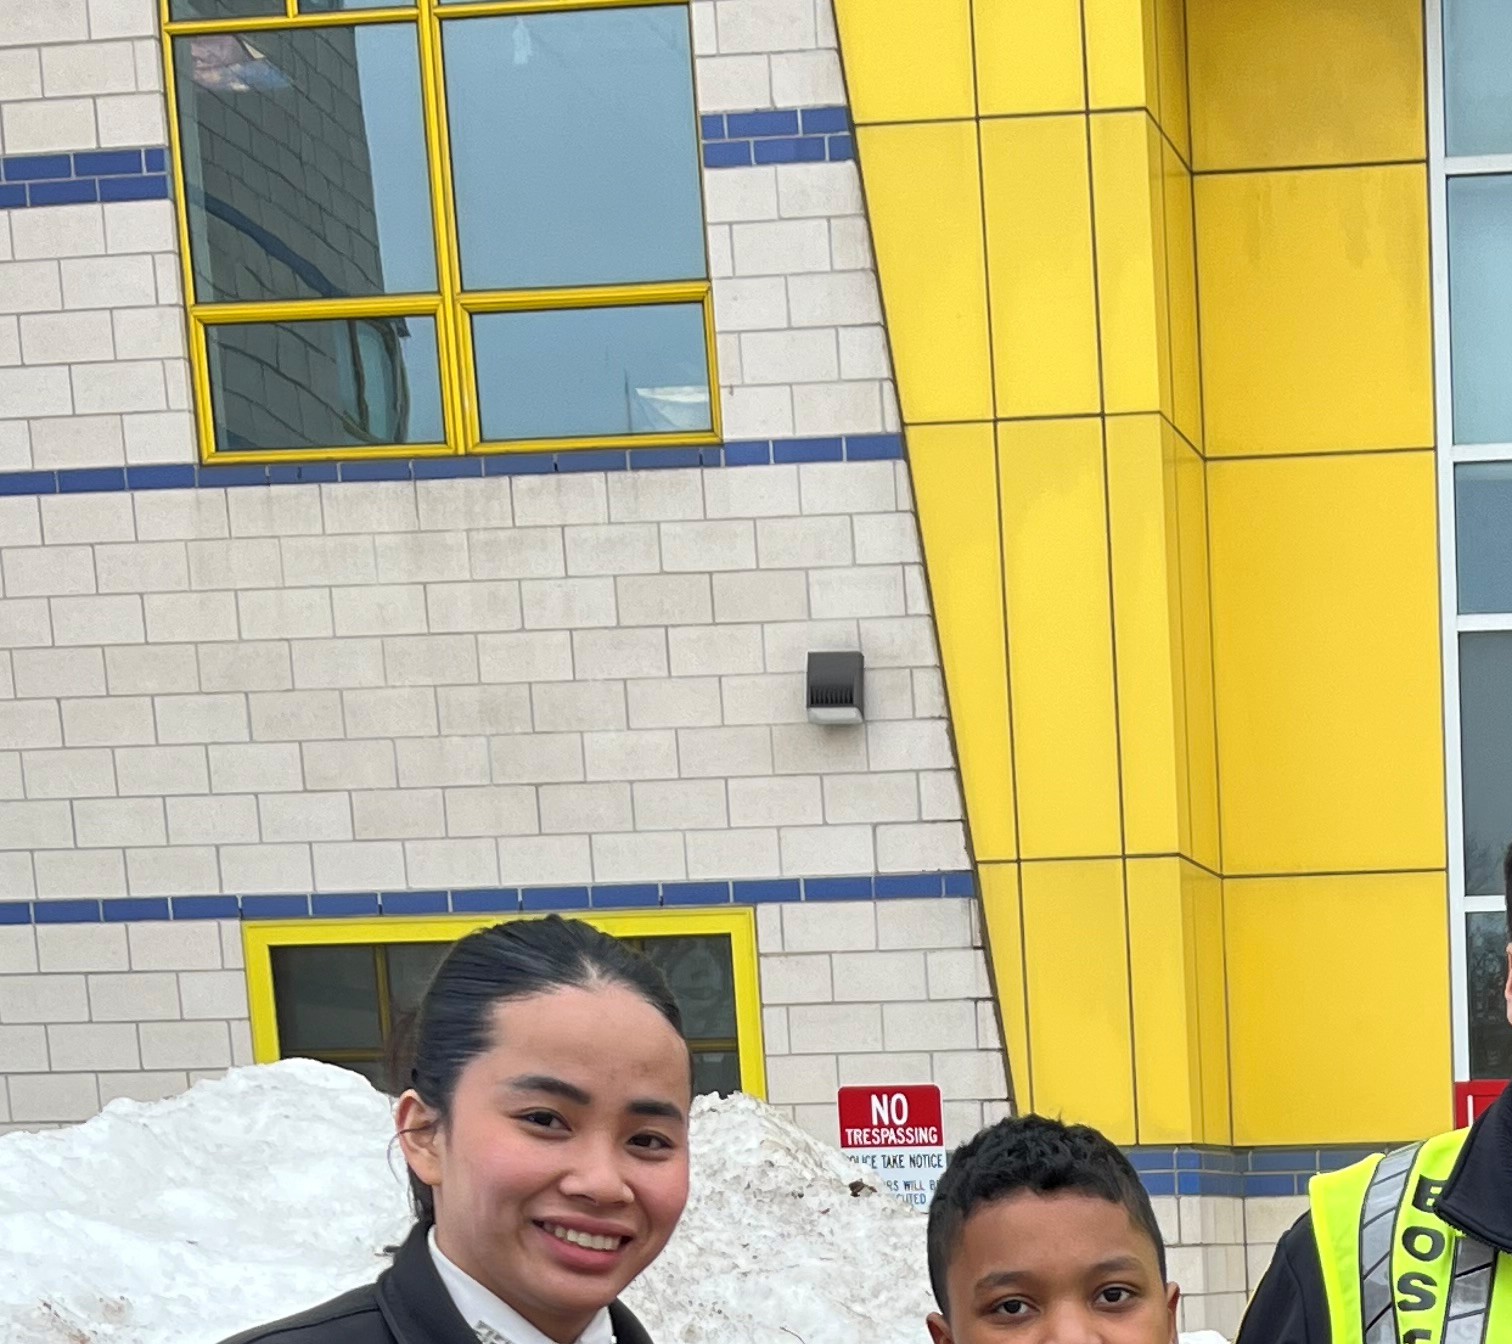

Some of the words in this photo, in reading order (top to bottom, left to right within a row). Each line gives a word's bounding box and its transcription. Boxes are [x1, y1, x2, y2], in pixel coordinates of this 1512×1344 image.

[870, 1093, 909, 1126] NO
[845, 1126, 938, 1146] TRESPASSING
[882, 1154, 904, 1169] TAKE
[909, 1153, 944, 1169] NOTICE
